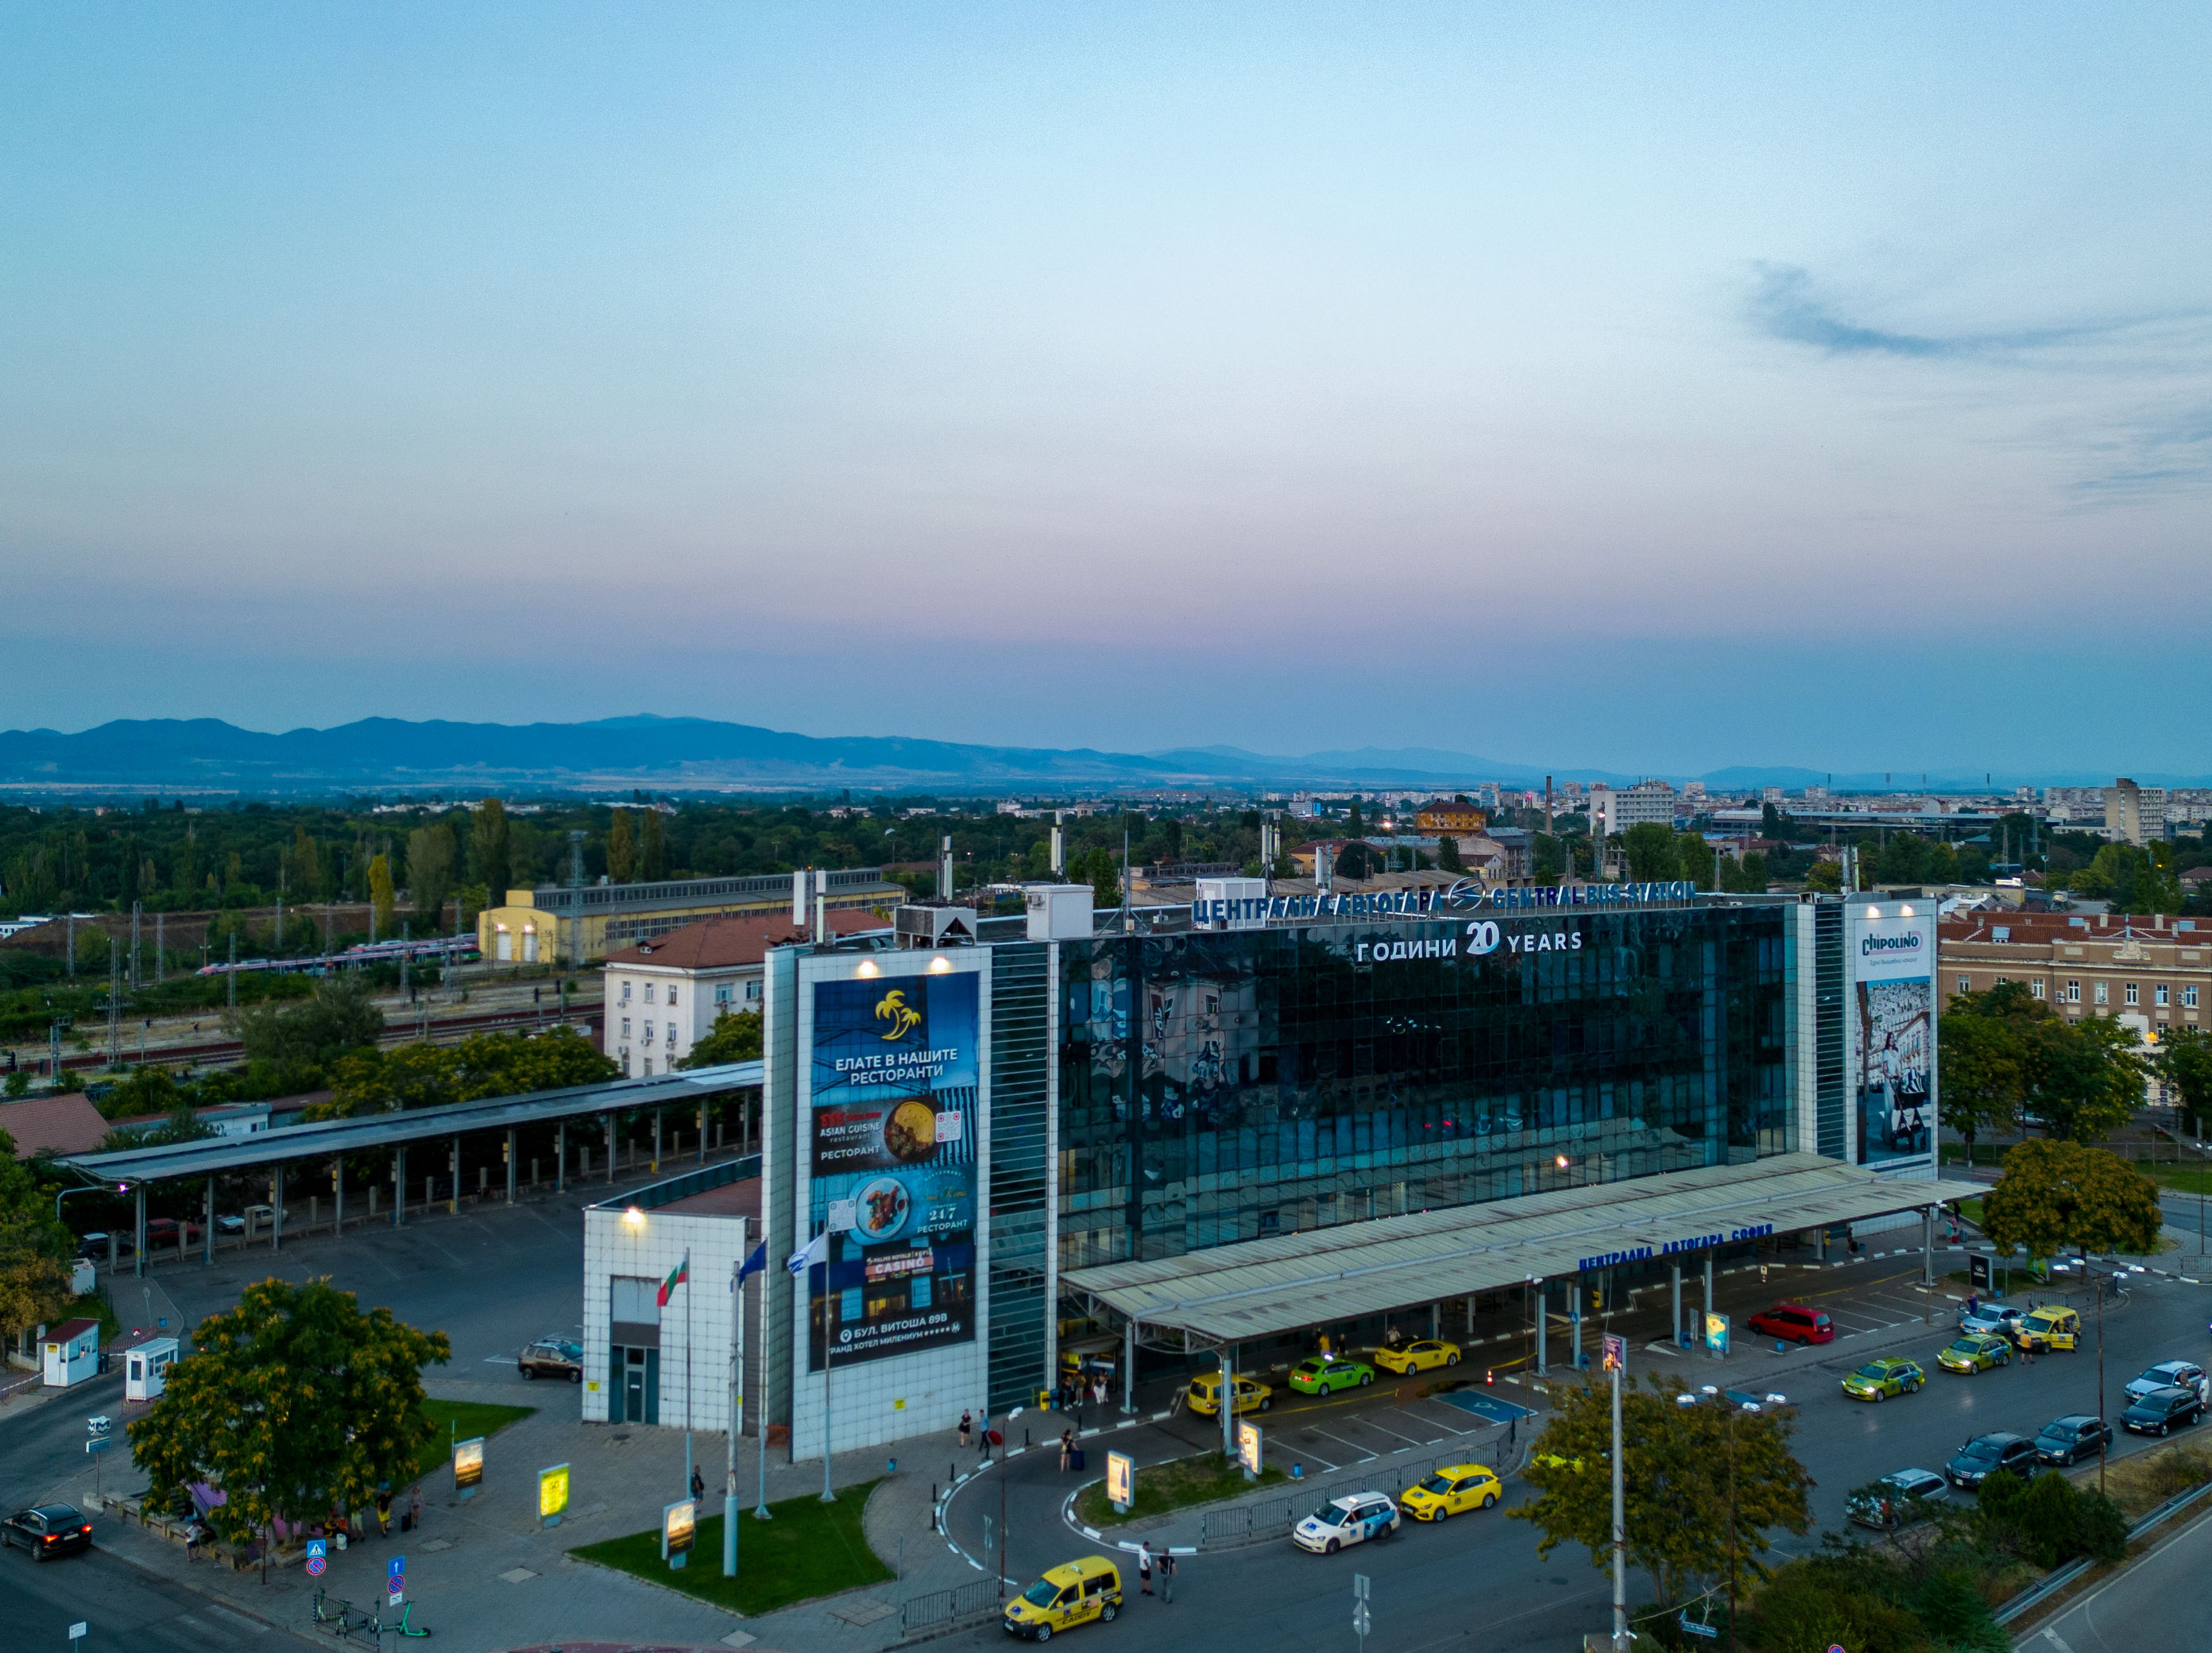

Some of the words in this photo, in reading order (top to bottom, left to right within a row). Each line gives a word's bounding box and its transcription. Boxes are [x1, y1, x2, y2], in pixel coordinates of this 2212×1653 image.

[1491, 886, 1581, 908] CENTRAL
[1584, 883, 1622, 904] BUS
[1624, 881, 1698, 903] STATION
[1193, 895, 1330, 922] ЦЕНТРАЛНА
[1334, 891, 1444, 915] АВТОГАРА
[1466, 920, 1501, 955] 20
[1506, 931, 1583, 954] YEARS
[1357, 939, 1457, 962] ГОДИНИ
[835, 1055, 882, 1072] ЕЛАТЕ
[885, 1054, 895, 1067] В
[898, 1048, 958, 1066] НАШИТЕ
[850, 1065, 943, 1085] РЕСТОРАНТИ
[820, 1125, 846, 1138] ASIAN
[848, 1121, 882, 1134] CUISINE
[821, 1144, 881, 1161] РЕСТОРАНТ
[917, 1219, 969, 1233] РЕСТОРАНТ
[1579, 1246, 1653, 1271] ЦЕНТРАЛНА
[1662, 1233, 1724, 1255] АВТОГАРА
[1731, 1223, 1773, 1241] СОФИЯ
[876, 1258, 925, 1274] CASINO
[853, 1326, 879, 1338] БУЛ.
[880, 1317, 926, 1334] ВИТОША
[854, 1339, 879, 1350] ХОТЕЛ
[880, 1330, 923, 1346] МИЛЕНИУМ
